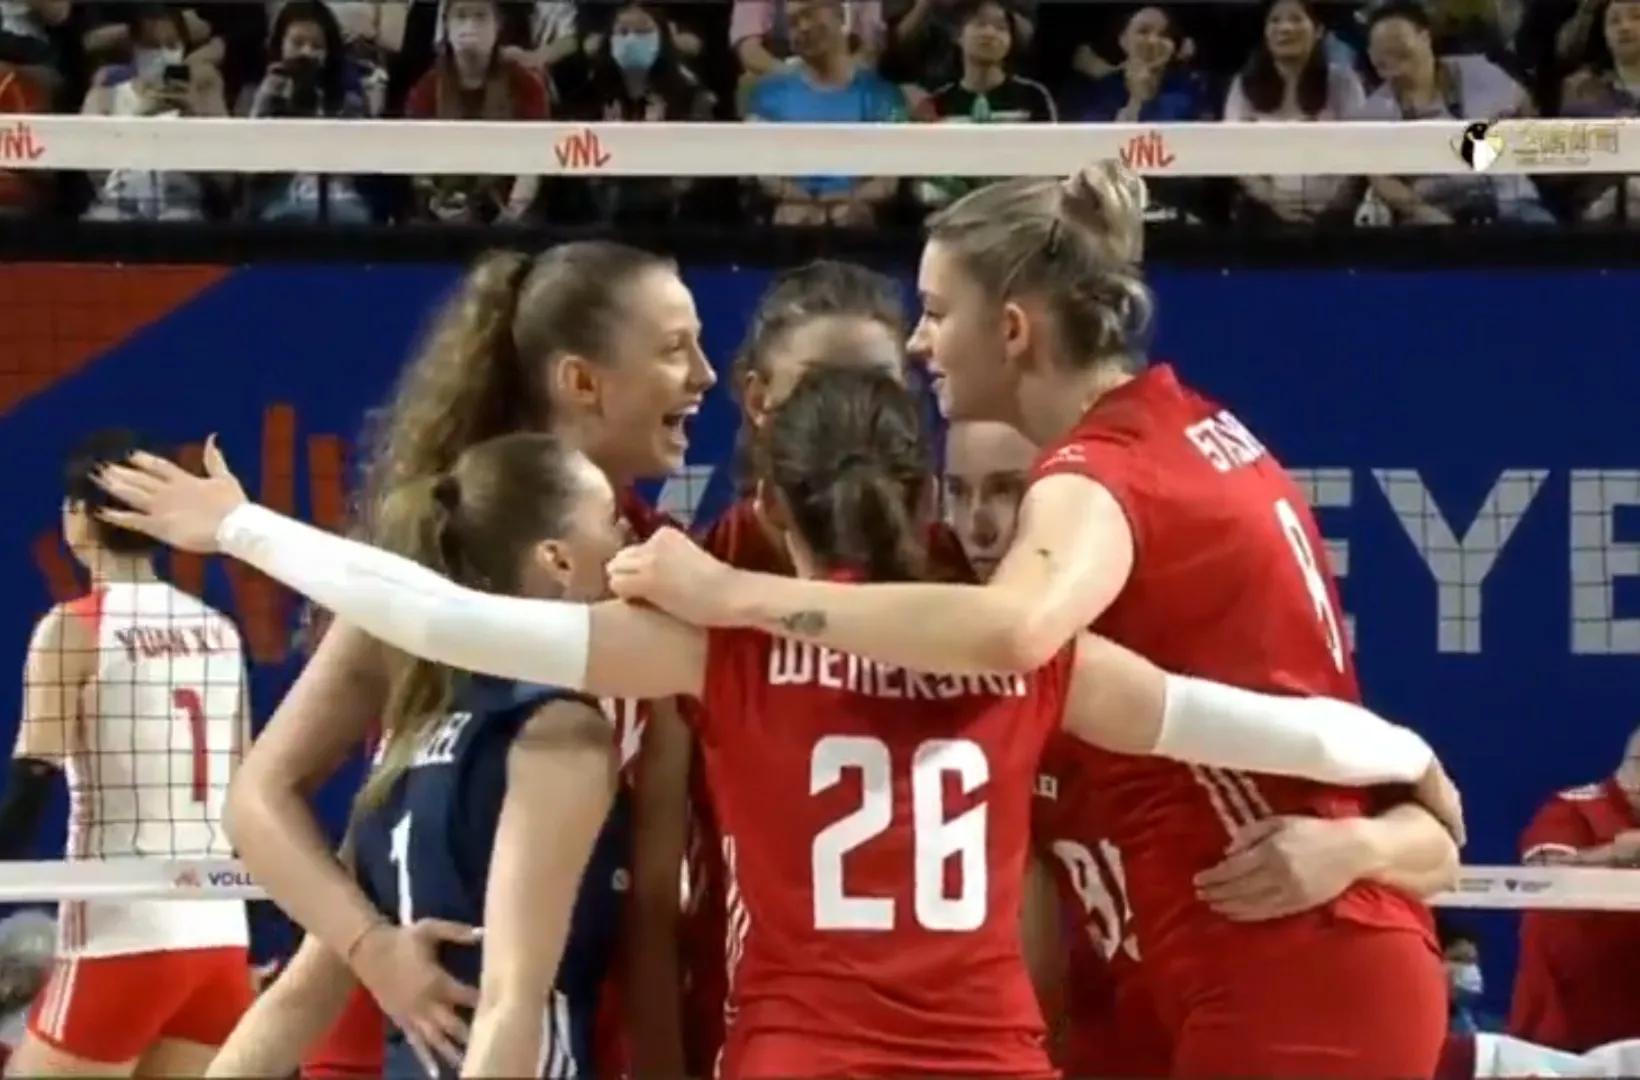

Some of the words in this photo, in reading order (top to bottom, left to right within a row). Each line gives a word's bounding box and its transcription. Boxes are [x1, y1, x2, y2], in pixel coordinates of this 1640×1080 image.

[554, 127, 611, 168] VNL
[1119, 129, 1176, 169] VNL
[171, 687, 207, 802] 1
[389, 811, 414, 925] 1
[809, 735, 990, 932] 26
